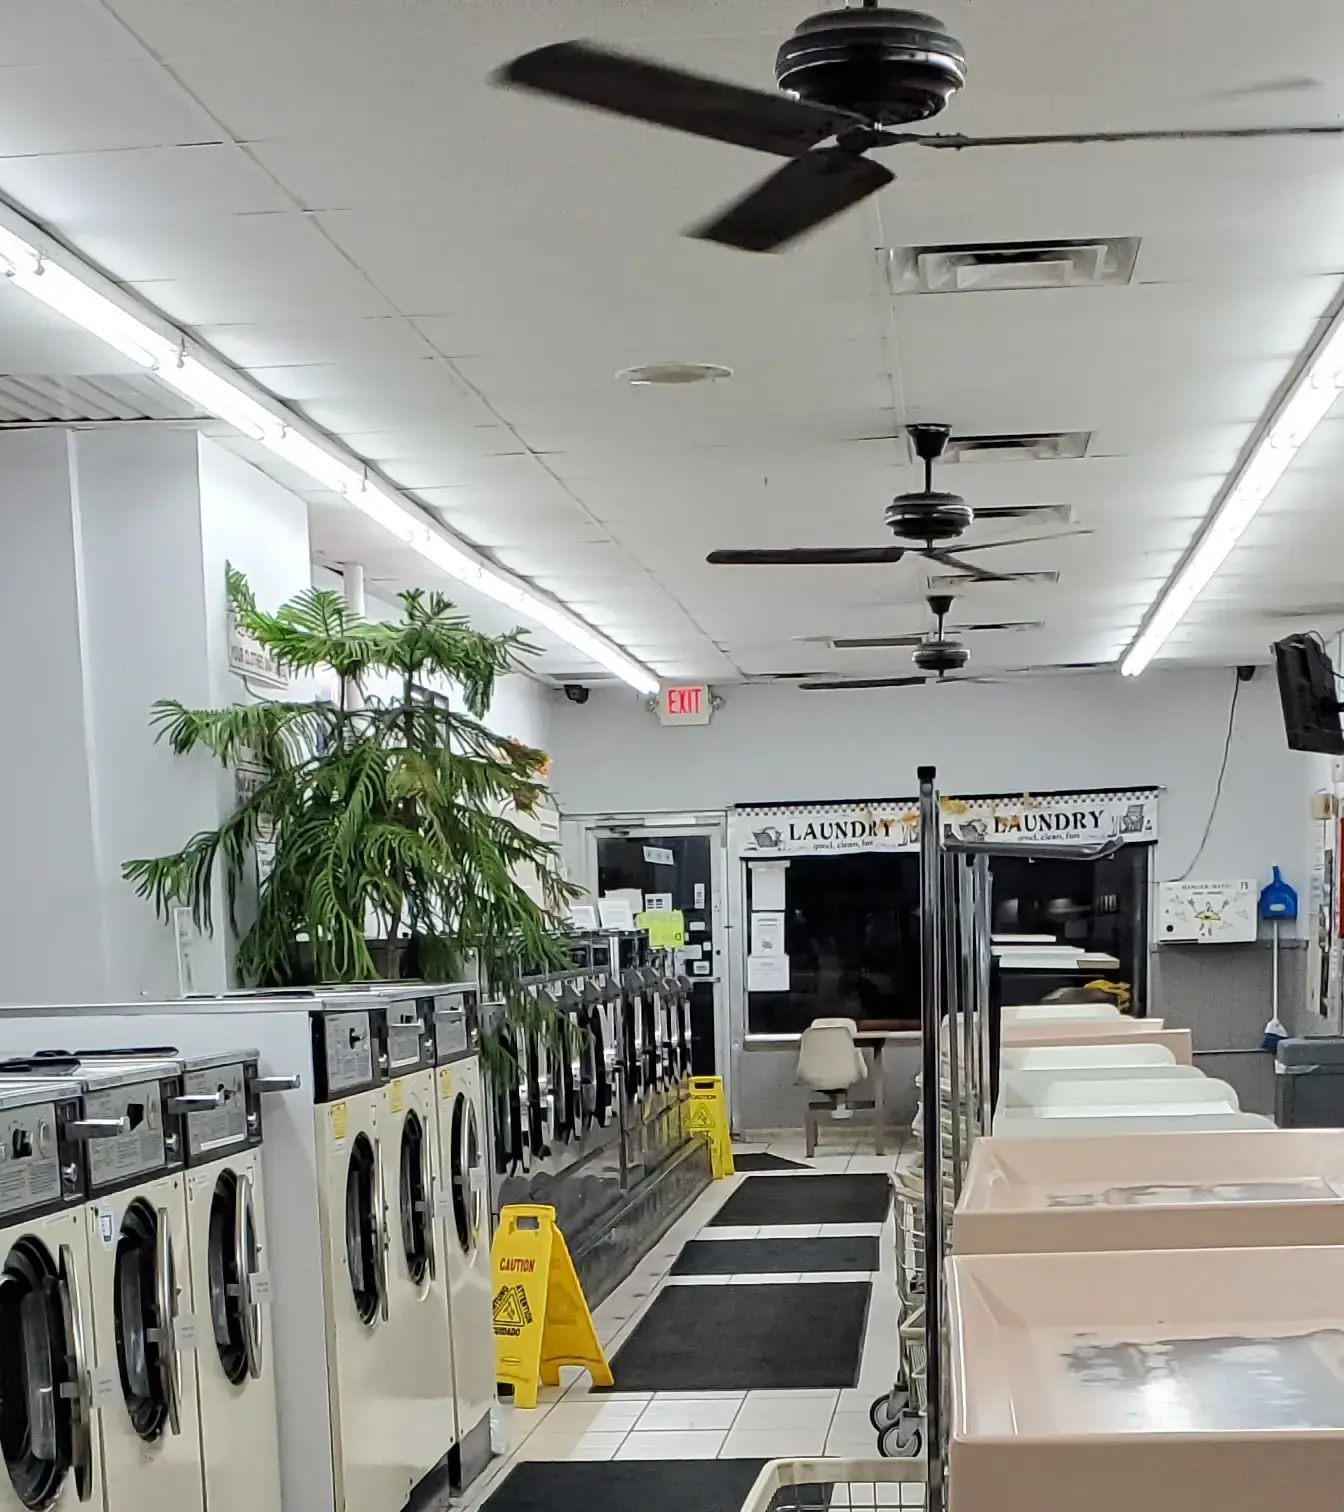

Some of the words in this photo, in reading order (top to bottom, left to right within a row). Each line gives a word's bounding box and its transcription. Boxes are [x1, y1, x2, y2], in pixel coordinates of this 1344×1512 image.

[667, 688, 701, 714] EXIT
[788, 818, 892, 842] LAUNDRY
[993, 809, 1105, 834] LAUNDRY
[499, 1256, 536, 1273] CAUTION
[515, 1283, 534, 1325] ATTENTION
